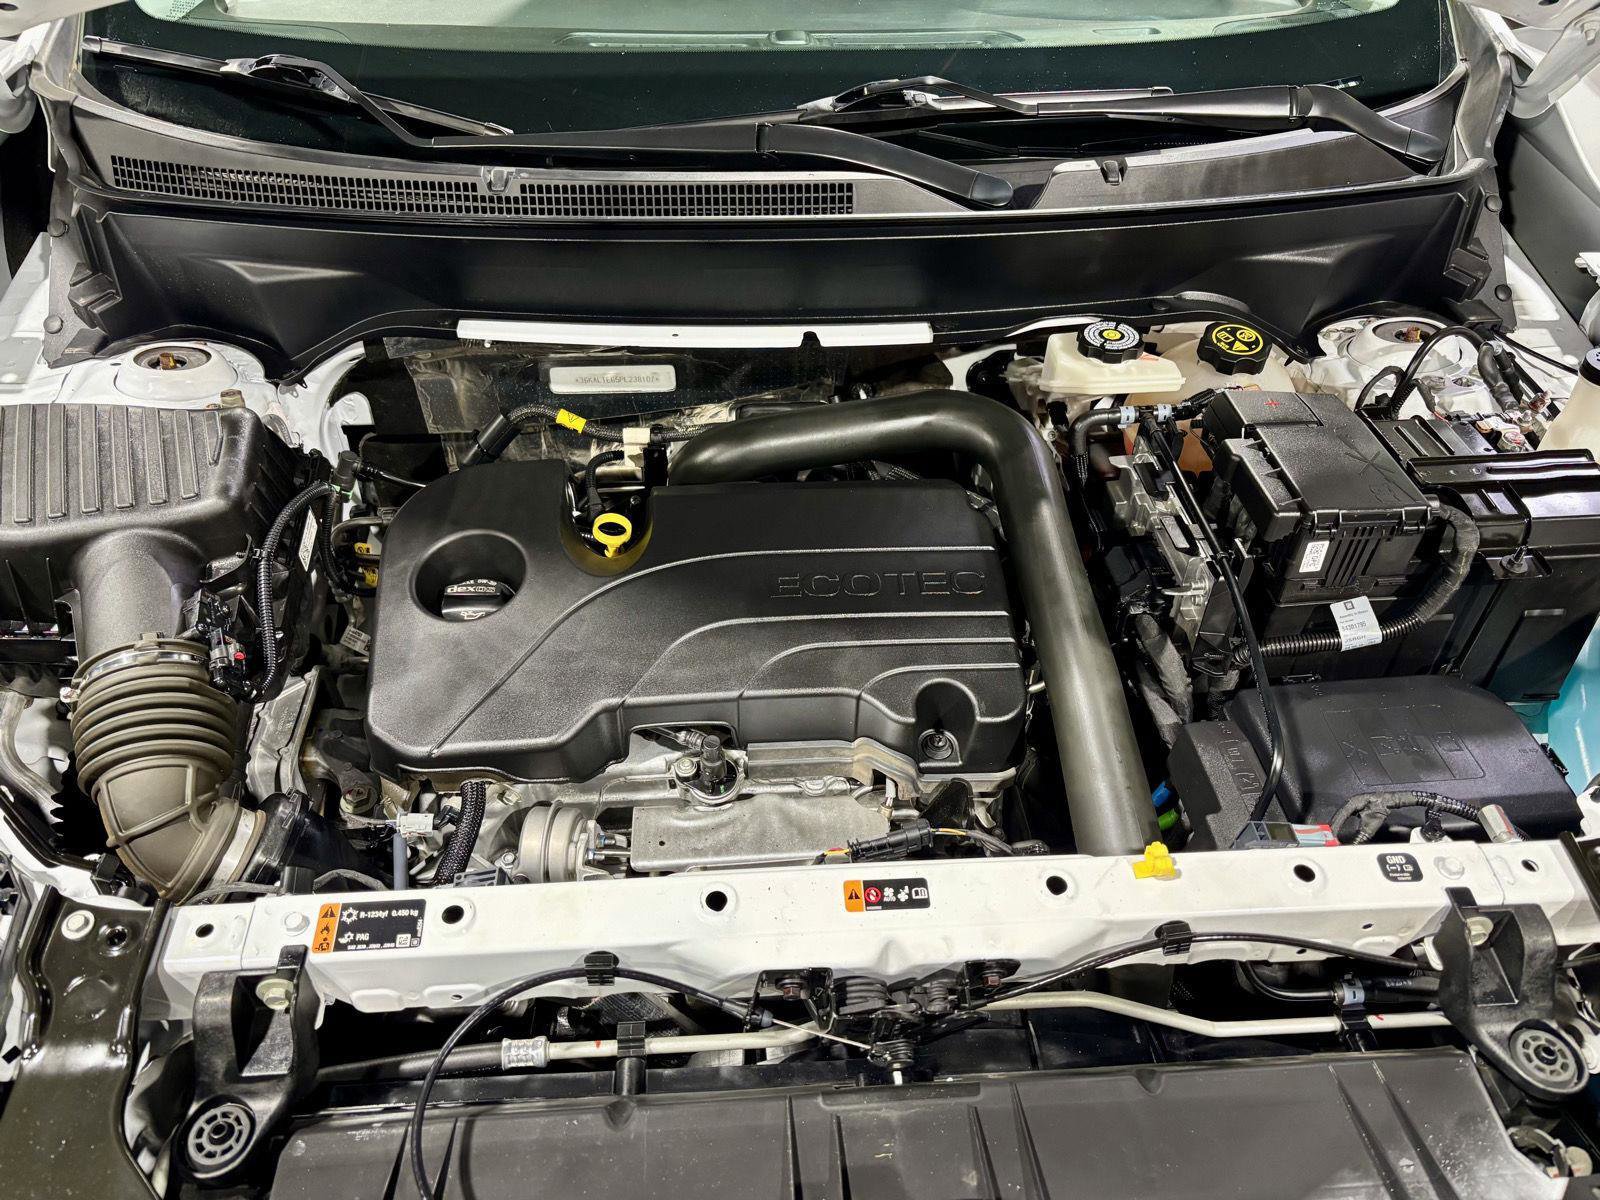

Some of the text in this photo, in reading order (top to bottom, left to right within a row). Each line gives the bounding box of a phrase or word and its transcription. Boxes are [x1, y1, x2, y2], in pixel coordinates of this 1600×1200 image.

[770, 571, 985, 598] ECOTEC
[1385, 855, 1406, 864] GND
[355, 932, 370, 941] PAG
